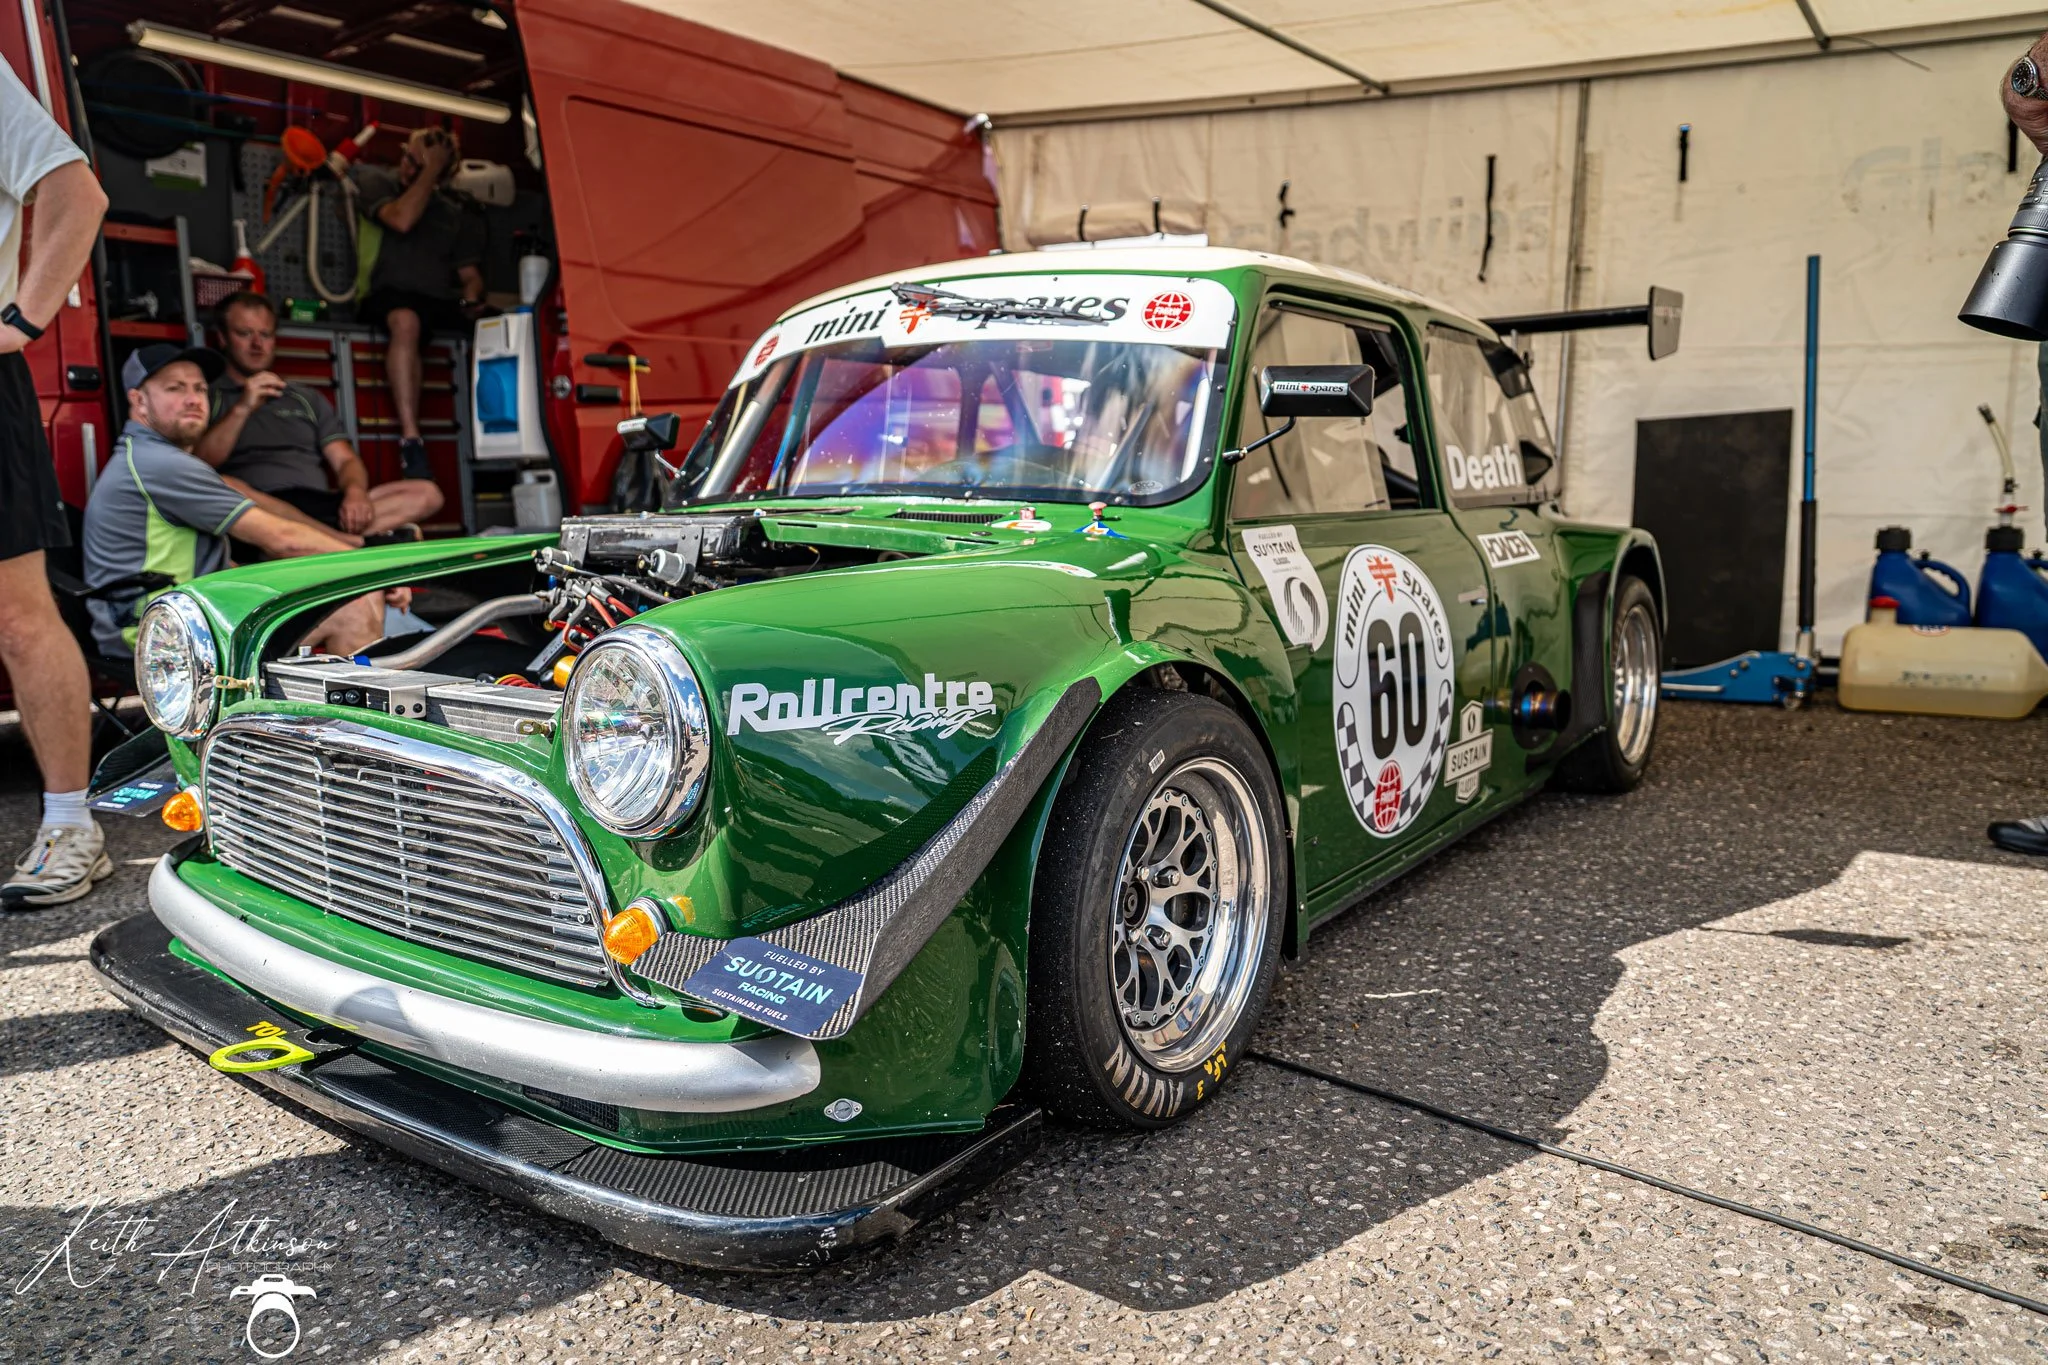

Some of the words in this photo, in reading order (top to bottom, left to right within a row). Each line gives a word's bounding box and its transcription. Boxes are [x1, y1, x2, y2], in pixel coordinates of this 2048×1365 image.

[804, 300, 891, 344] mini
[1276, 382, 1301, 391] mini
[1309, 384, 1344, 394] spares
[1445, 445, 1522, 490] Death
[1345, 571, 1366, 650] mini
[1402, 570, 1447, 653] spares
[727, 673, 996, 736] Rollcentre
[1367, 611, 1428, 760] 60
[821, 704, 992, 745] Racing
[1451, 742, 1488, 772] SUSTAIN
[763, 951, 809, 972] FUELLED
[809, 966, 826, 976] BY
[712, 988, 764, 1014] SUSTAINABLE
[761, 1006, 788, 1021] FUELS
[738, 981, 787, 1005] RACING
